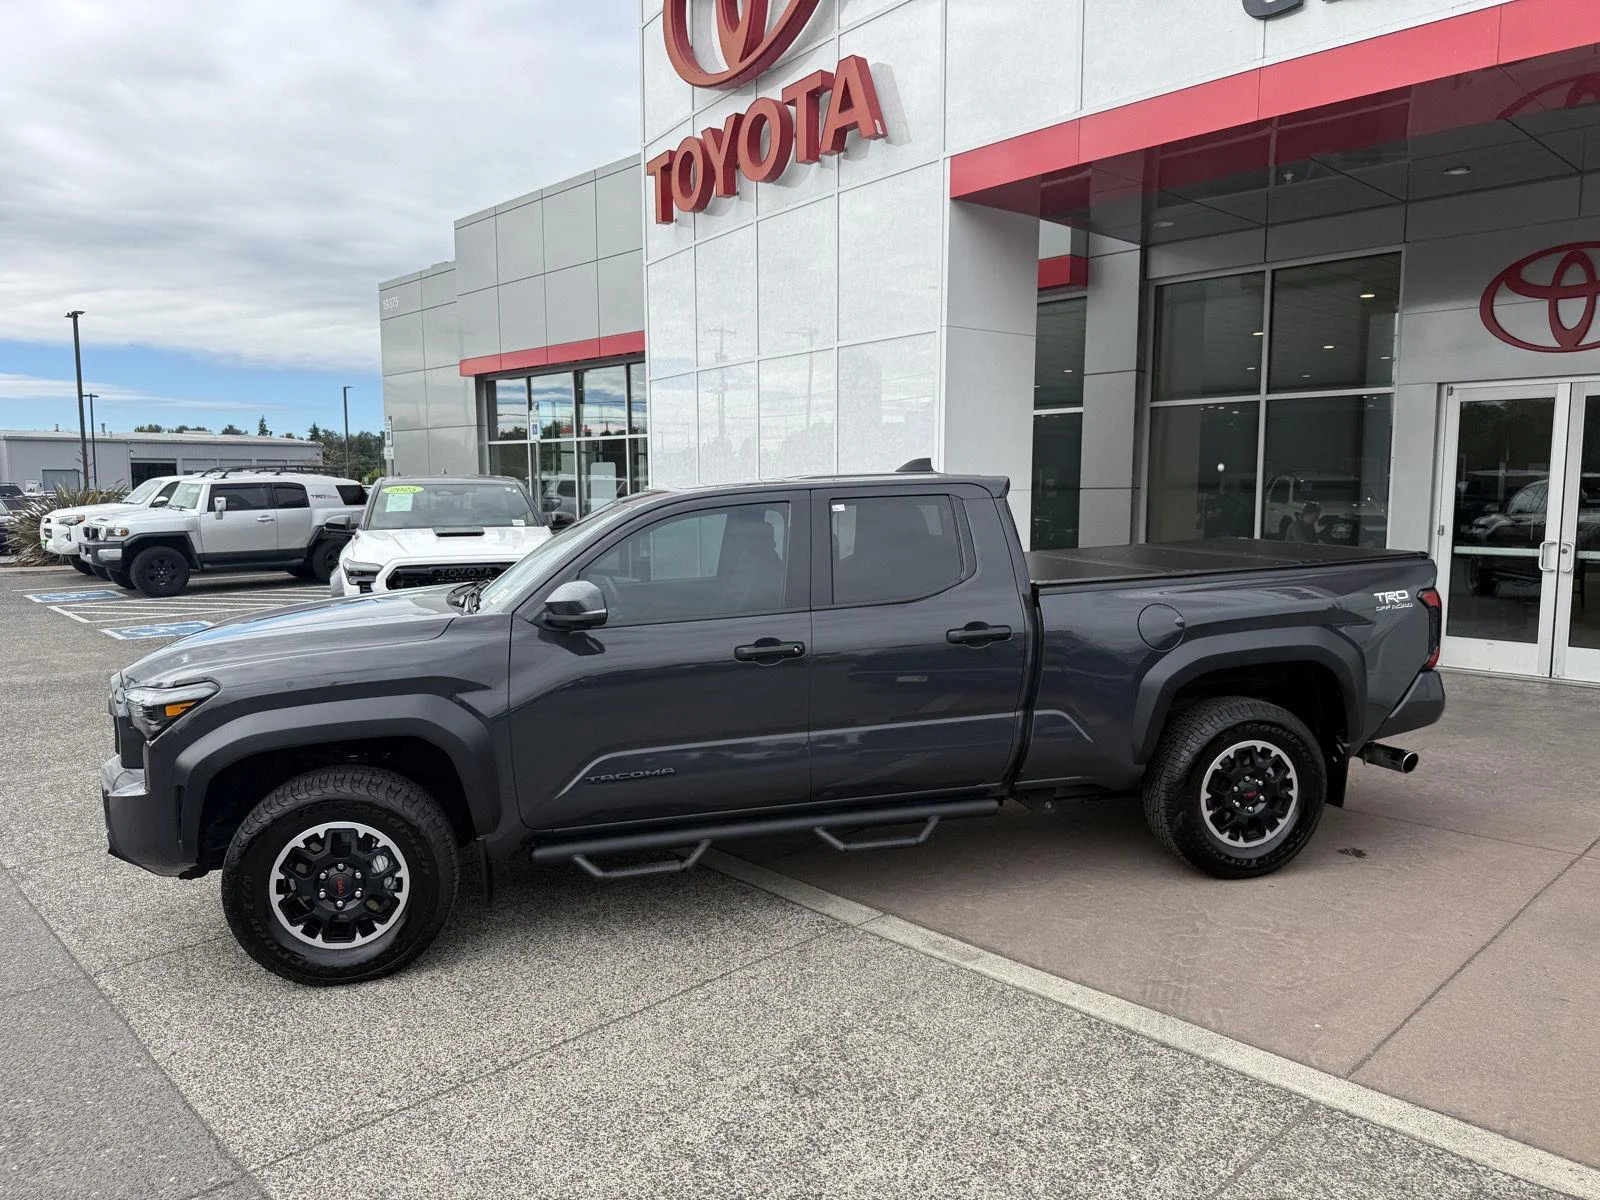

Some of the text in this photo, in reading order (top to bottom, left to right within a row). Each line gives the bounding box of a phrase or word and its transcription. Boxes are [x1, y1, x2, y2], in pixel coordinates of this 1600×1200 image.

[647, 55, 888, 224] TOYOTA
[440, 567, 492, 578] TOYOTA
[1373, 589, 1409, 604] TRD
[585, 767, 676, 784] TACOMA
